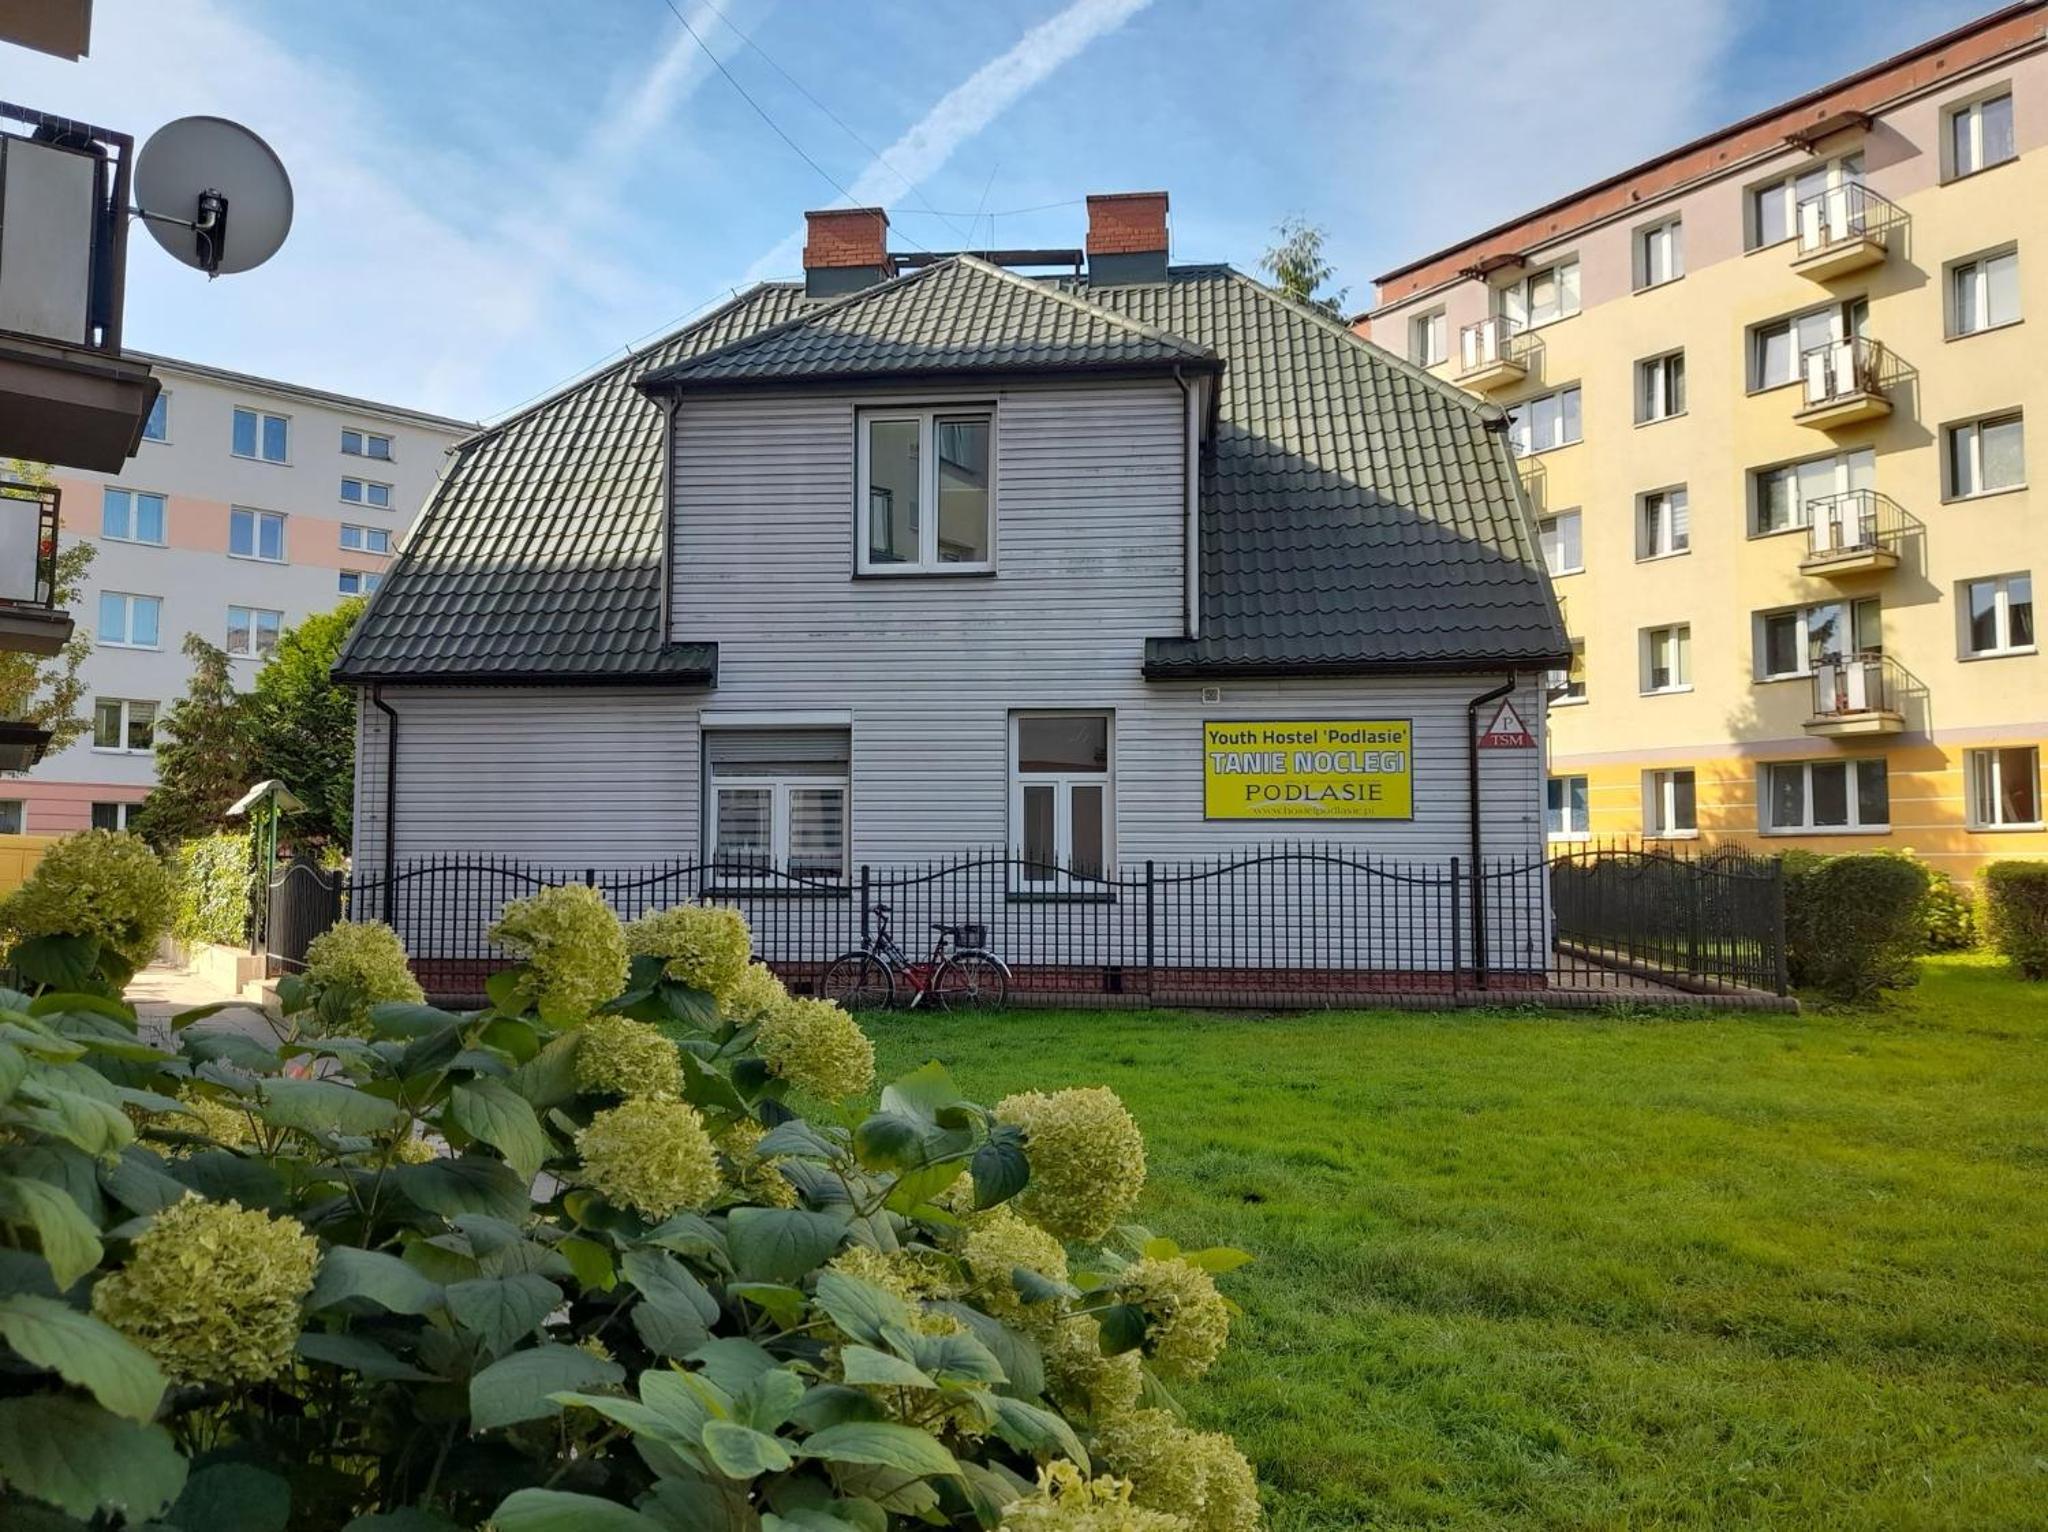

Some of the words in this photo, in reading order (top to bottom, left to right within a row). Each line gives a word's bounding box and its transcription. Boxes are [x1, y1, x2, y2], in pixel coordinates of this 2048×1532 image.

[1502, 716, 1513, 730] P
[1209, 730, 1257, 744] Youth
[1263, 730, 1318, 744] Hostel
[1491, 734, 1523, 746] TSM
[1210, 752, 1287, 774] TANIE
[1294, 751, 1405, 774] NOCLEGI
[1245, 784, 1382, 801] PODLASIE
